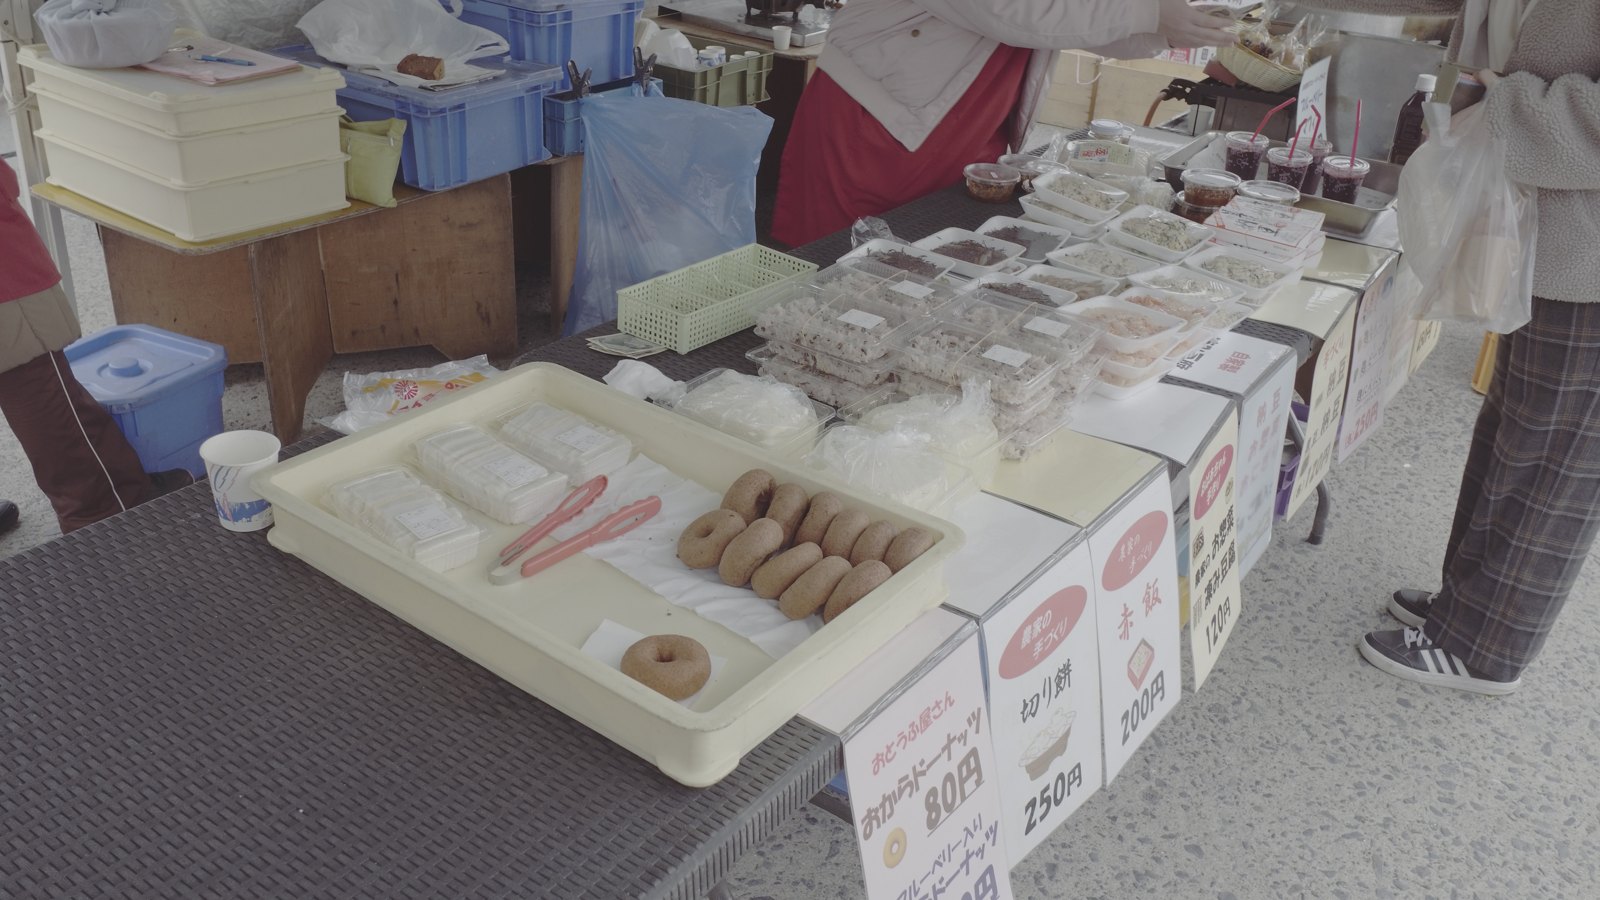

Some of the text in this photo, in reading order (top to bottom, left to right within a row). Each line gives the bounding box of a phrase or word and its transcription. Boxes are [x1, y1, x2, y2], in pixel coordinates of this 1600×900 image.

[1020, 609, 1052, 651] 農家の
[1033, 616, 1068, 661] 手づくり
[1118, 577, 1162, 641] 赤飯
[1206, 596, 1231, 655] 120円
[1020, 657, 1072, 724] 切り餅
[1120, 669, 1165, 747] 200円
[871, 690, 956, 777] おとうふ屋さん
[860, 706, 982, 842] おからドーナッツ
[924, 746, 984, 831] 80円
[1024, 761, 1083, 837] 250円
